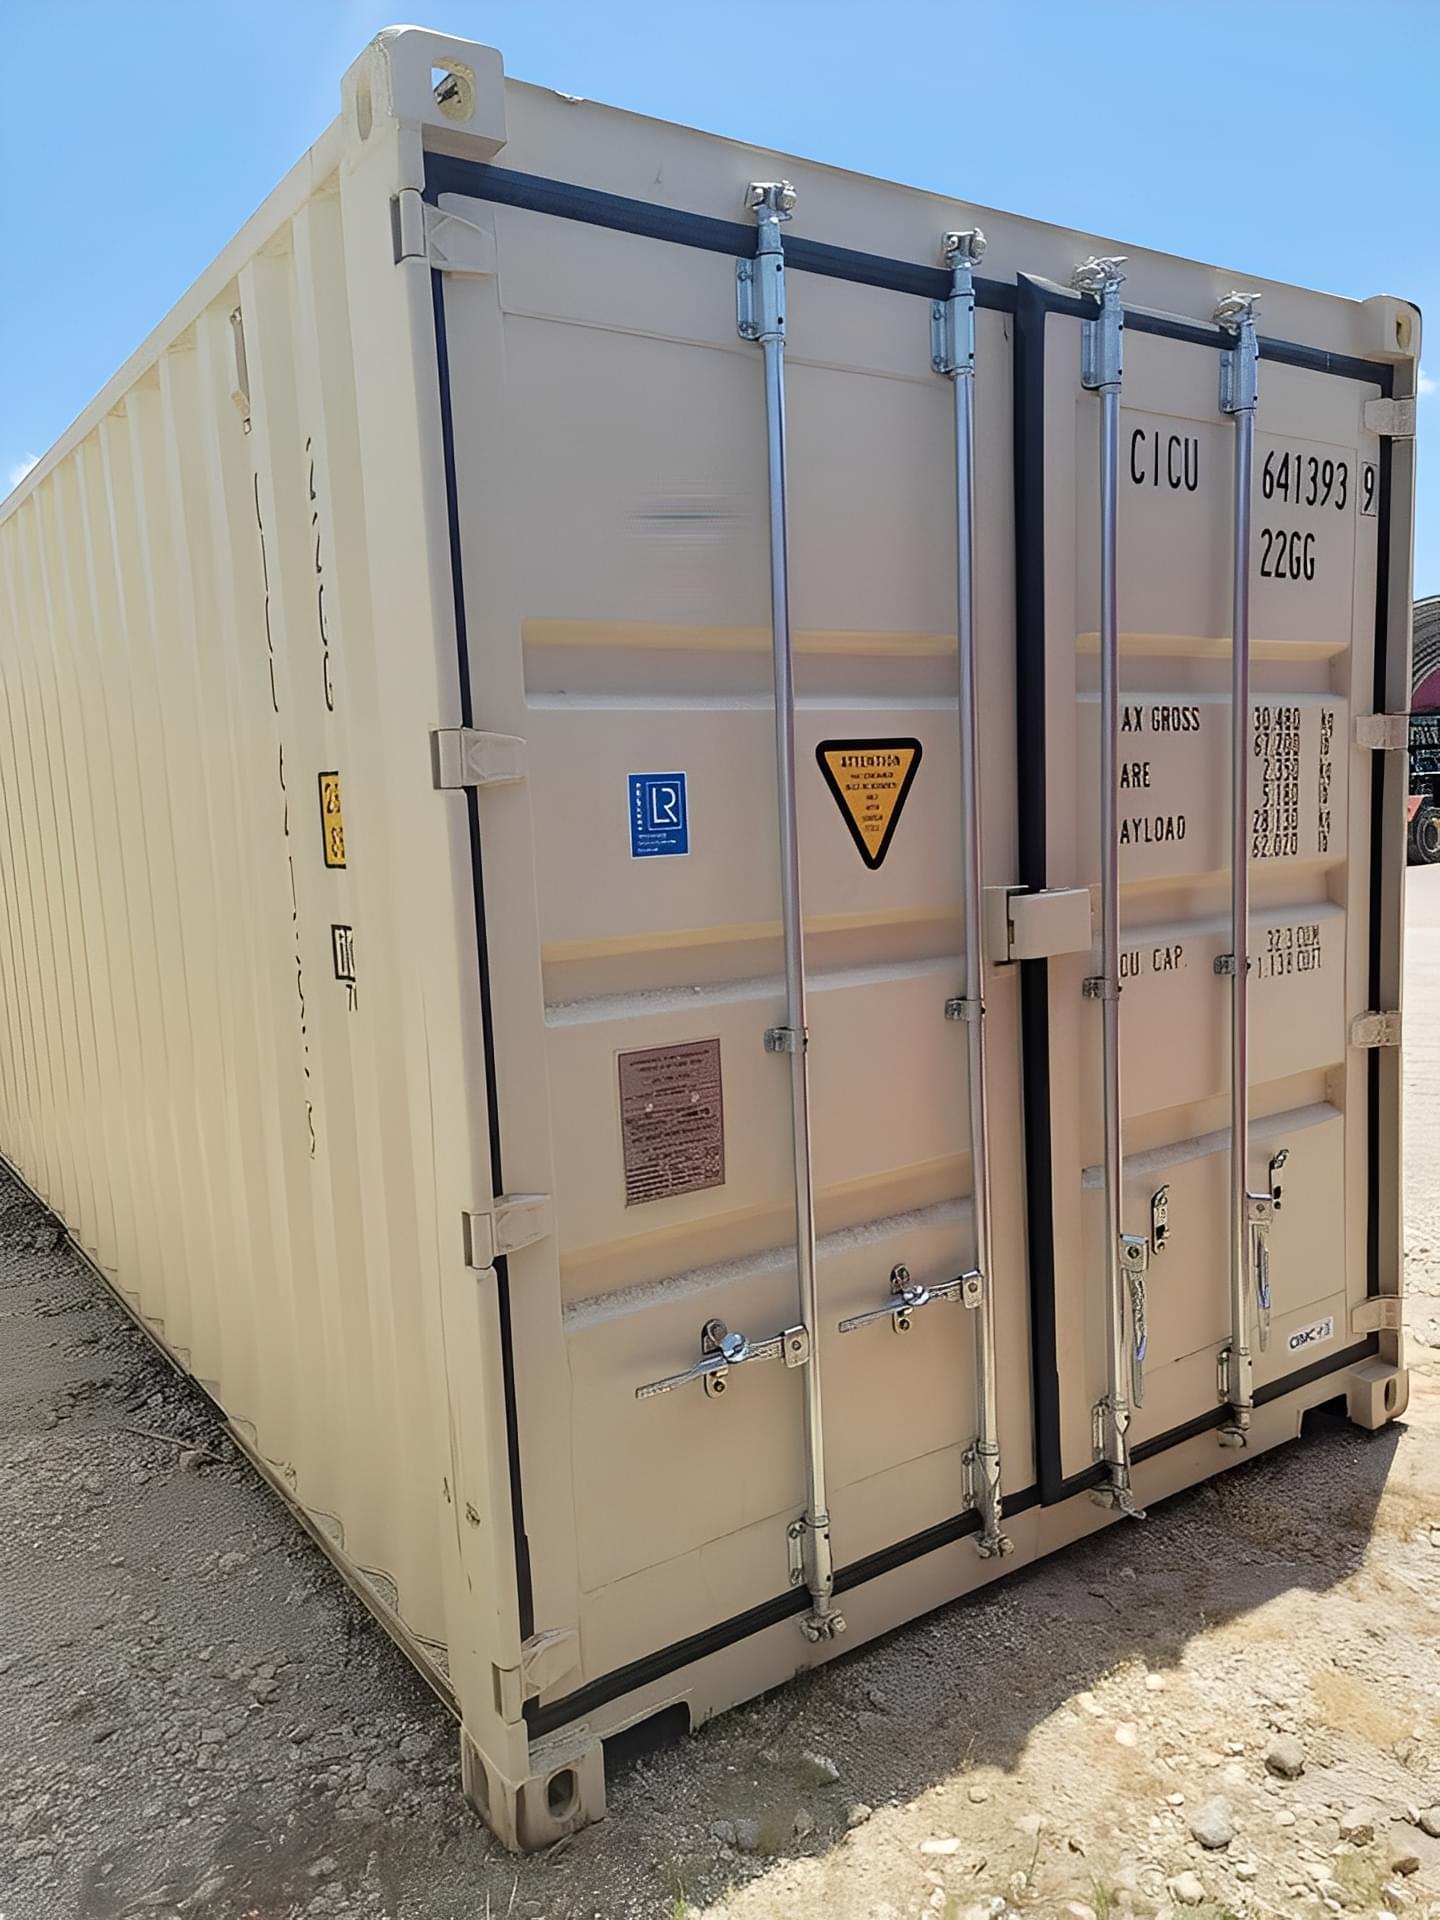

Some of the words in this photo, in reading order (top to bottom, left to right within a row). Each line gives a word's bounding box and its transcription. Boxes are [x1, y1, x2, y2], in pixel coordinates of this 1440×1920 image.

[1131, 429, 1198, 491] CICU
[1262, 450, 1347, 510] 641393
[1364, 466, 1375, 511] 9
[1260, 528, 1315, 580] 22GG
[1121, 706, 1143, 732] AX
[1152, 707, 1200, 732] GROSS
[1120, 762, 1151, 788] ARE
[1120, 816, 1186, 844] AYLOAD
